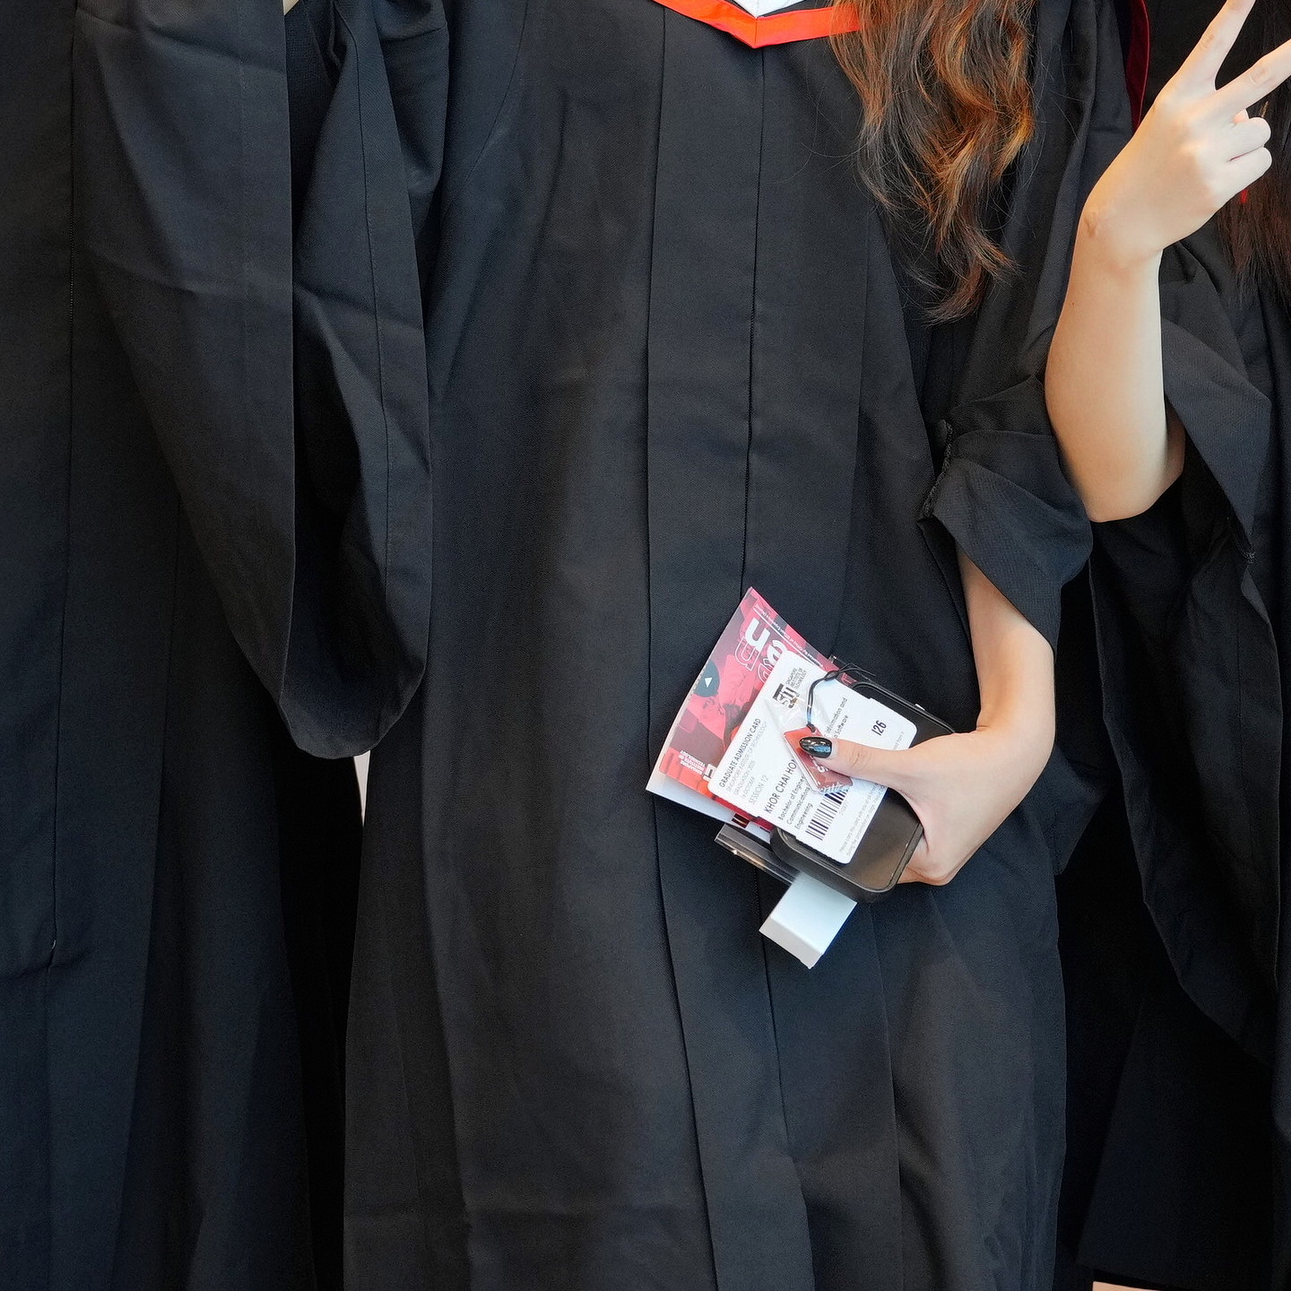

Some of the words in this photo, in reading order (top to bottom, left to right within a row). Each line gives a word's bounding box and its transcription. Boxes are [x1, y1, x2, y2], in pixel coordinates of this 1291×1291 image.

[870, 720, 887, 736] 126
[719, 761, 737, 788] GRADUATE
[734, 733, 753, 761] ADMISSION
[749, 718, 761, 734] CARD
[778, 799, 793, 820] Bachelor
[839, 697, 848, 708] and
[786, 786, 811, 825] Communications
[835, 714, 849, 734] Software
[749, 782, 764, 805] SESSION
[764, 792, 781, 814] KHOR
[775, 773, 791, 793] CHAI
[795, 802, 814, 830] Engineering
